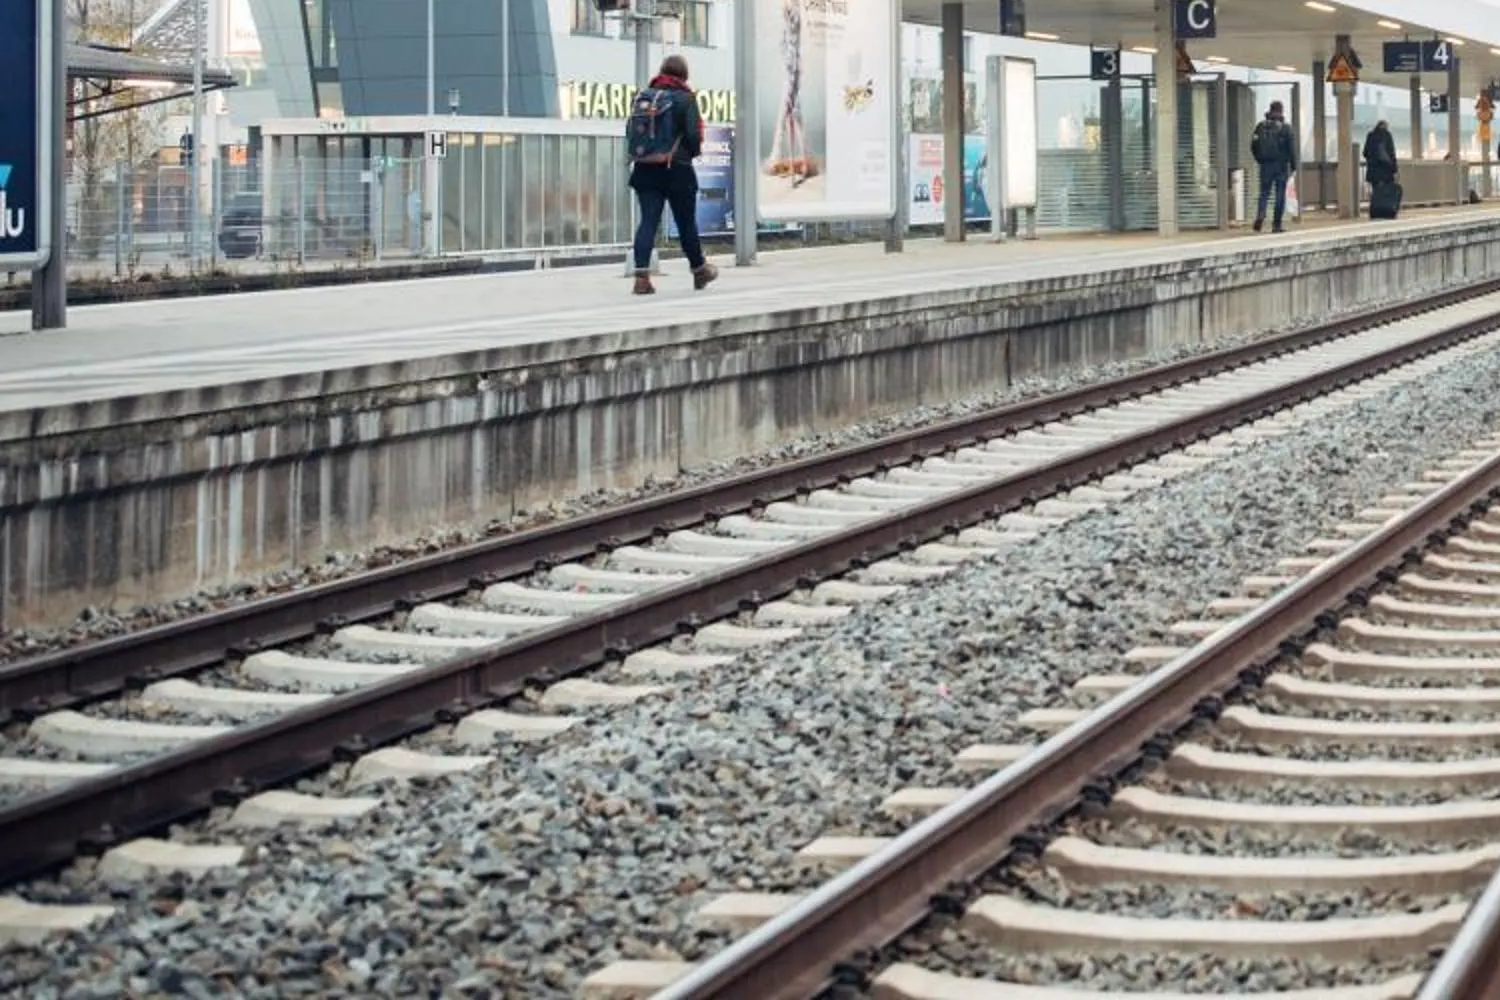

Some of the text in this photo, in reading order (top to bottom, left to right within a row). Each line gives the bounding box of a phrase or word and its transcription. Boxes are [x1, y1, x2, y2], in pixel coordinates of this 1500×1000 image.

[1187, 0, 1210, 29] C
[1103, 51, 1117, 74] 3
[1433, 42, 1449, 65] 4
[696, 90, 736, 121] OME
[431, 133, 445, 156] H
